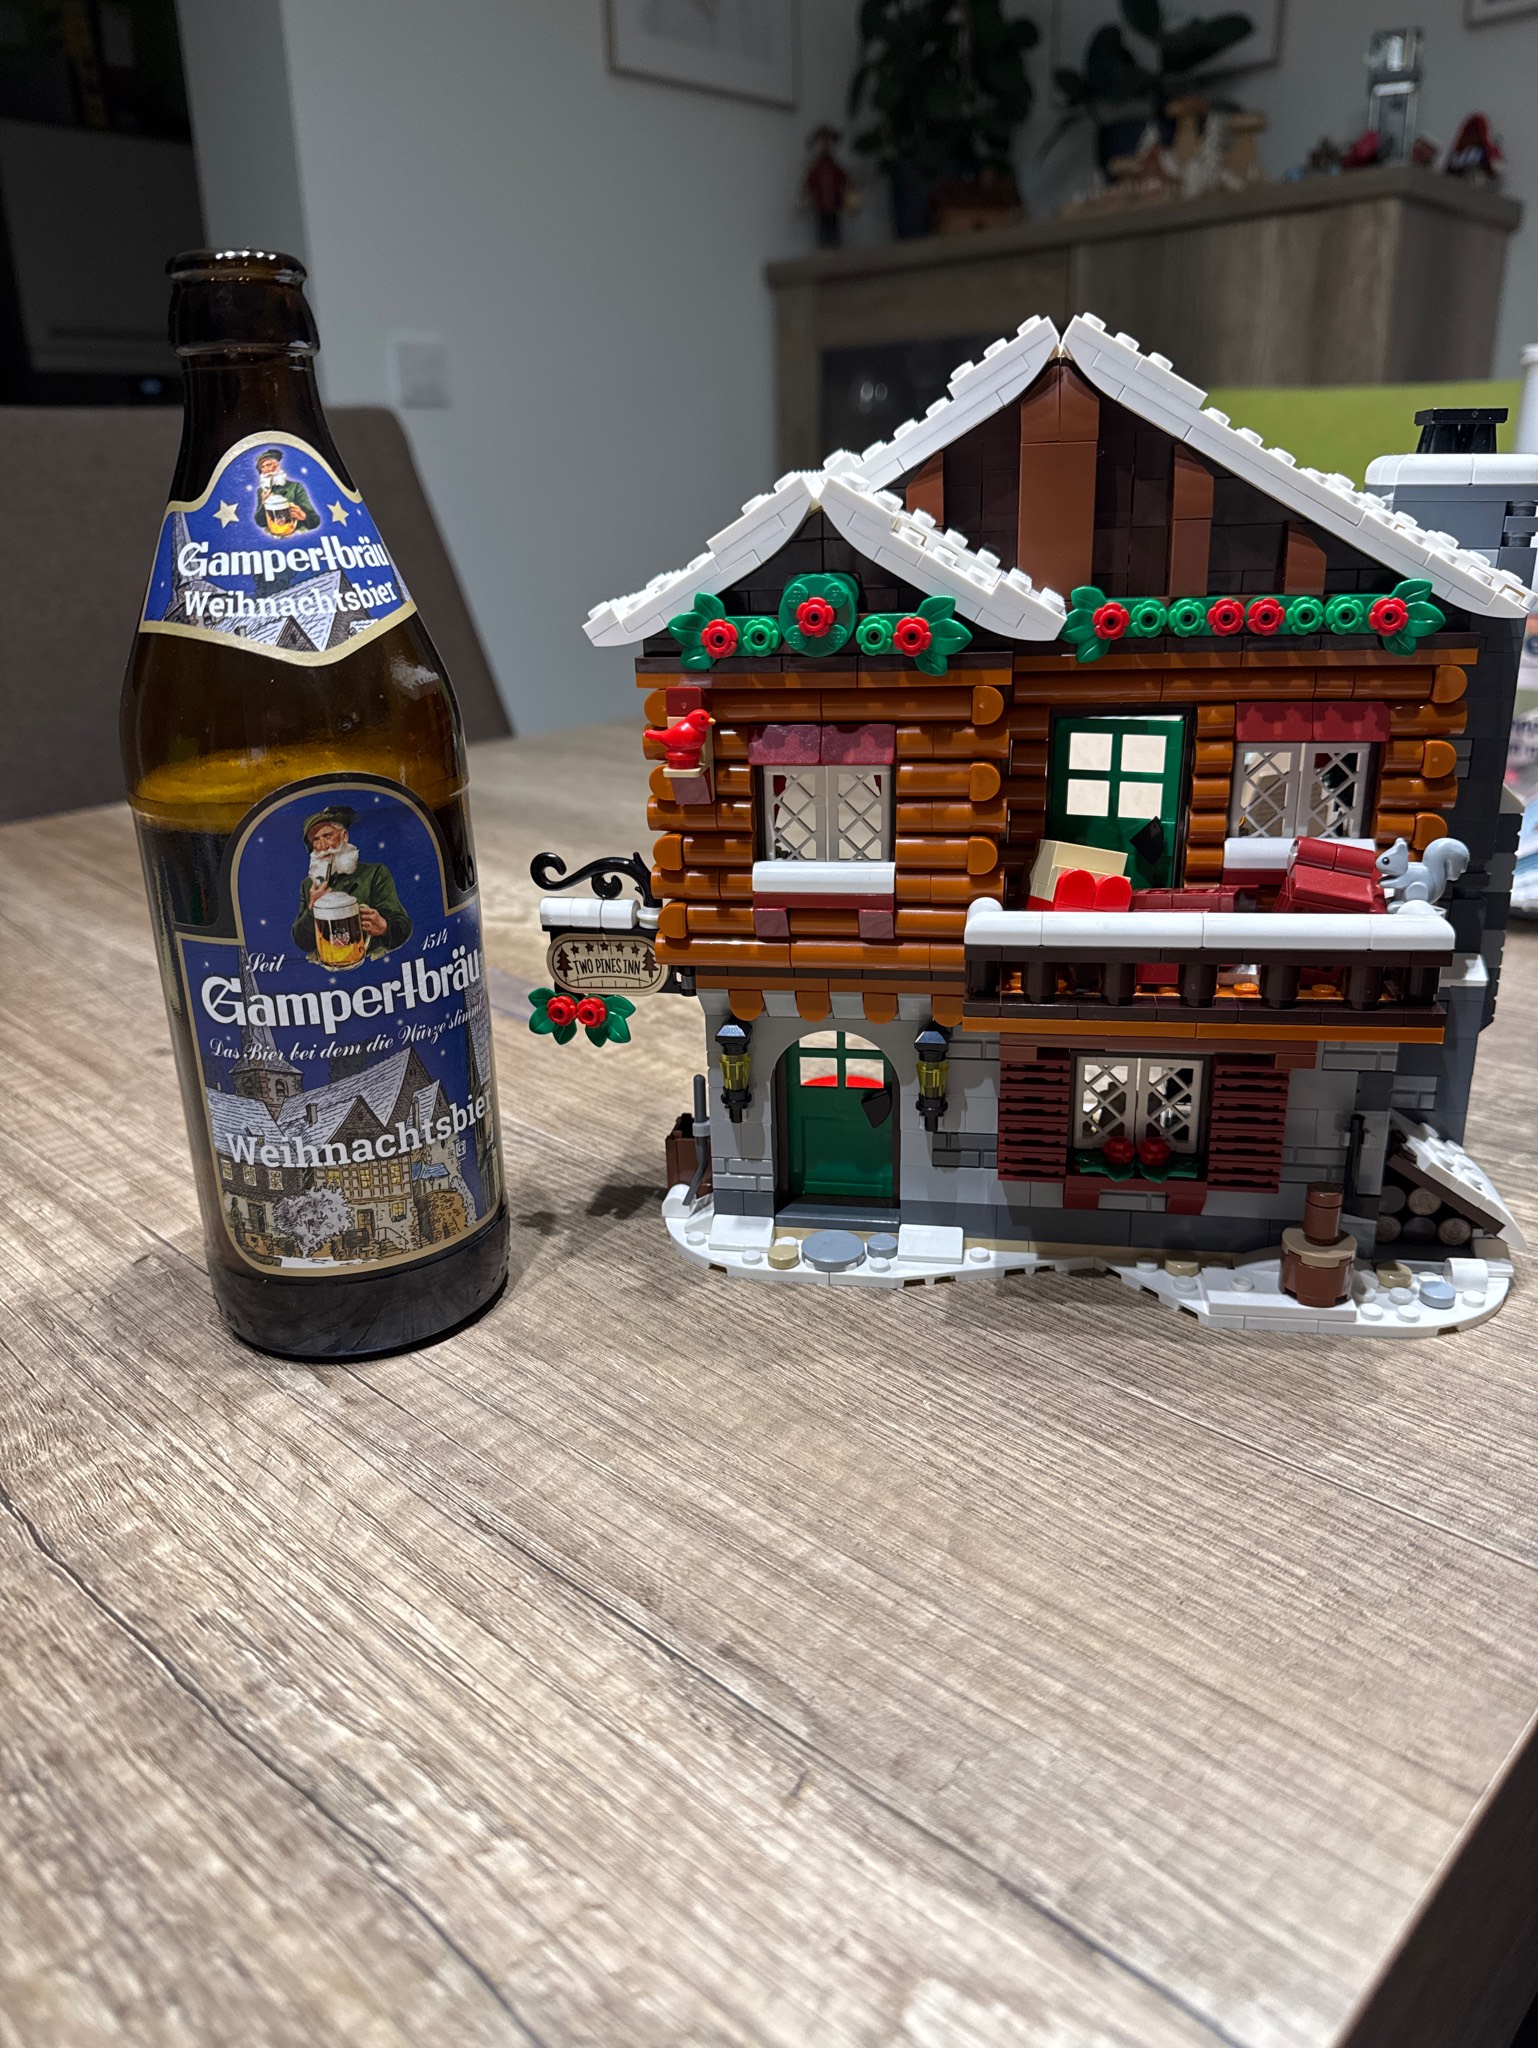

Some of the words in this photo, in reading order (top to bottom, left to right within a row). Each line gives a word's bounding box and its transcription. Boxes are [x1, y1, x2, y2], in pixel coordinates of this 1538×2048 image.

[184, 580, 397, 617] Weihnachtsbier
[245, 953, 286, 972] Seit
[421, 928, 448, 951] 1514
[573, 958, 594, 975] TWO
[596, 958, 622, 974] PINES
[623, 959, 641, 975] INN
[209, 1038, 240, 1059] Das
[243, 1042, 285, 1060] Bier
[290, 1042, 316, 1060] bei
[320, 1041, 363, 1058] dem
[366, 1034, 394, 1053] die
[398, 1022, 446, 1045] Würze
[226, 1088, 493, 1168] Weihnachtsbier
